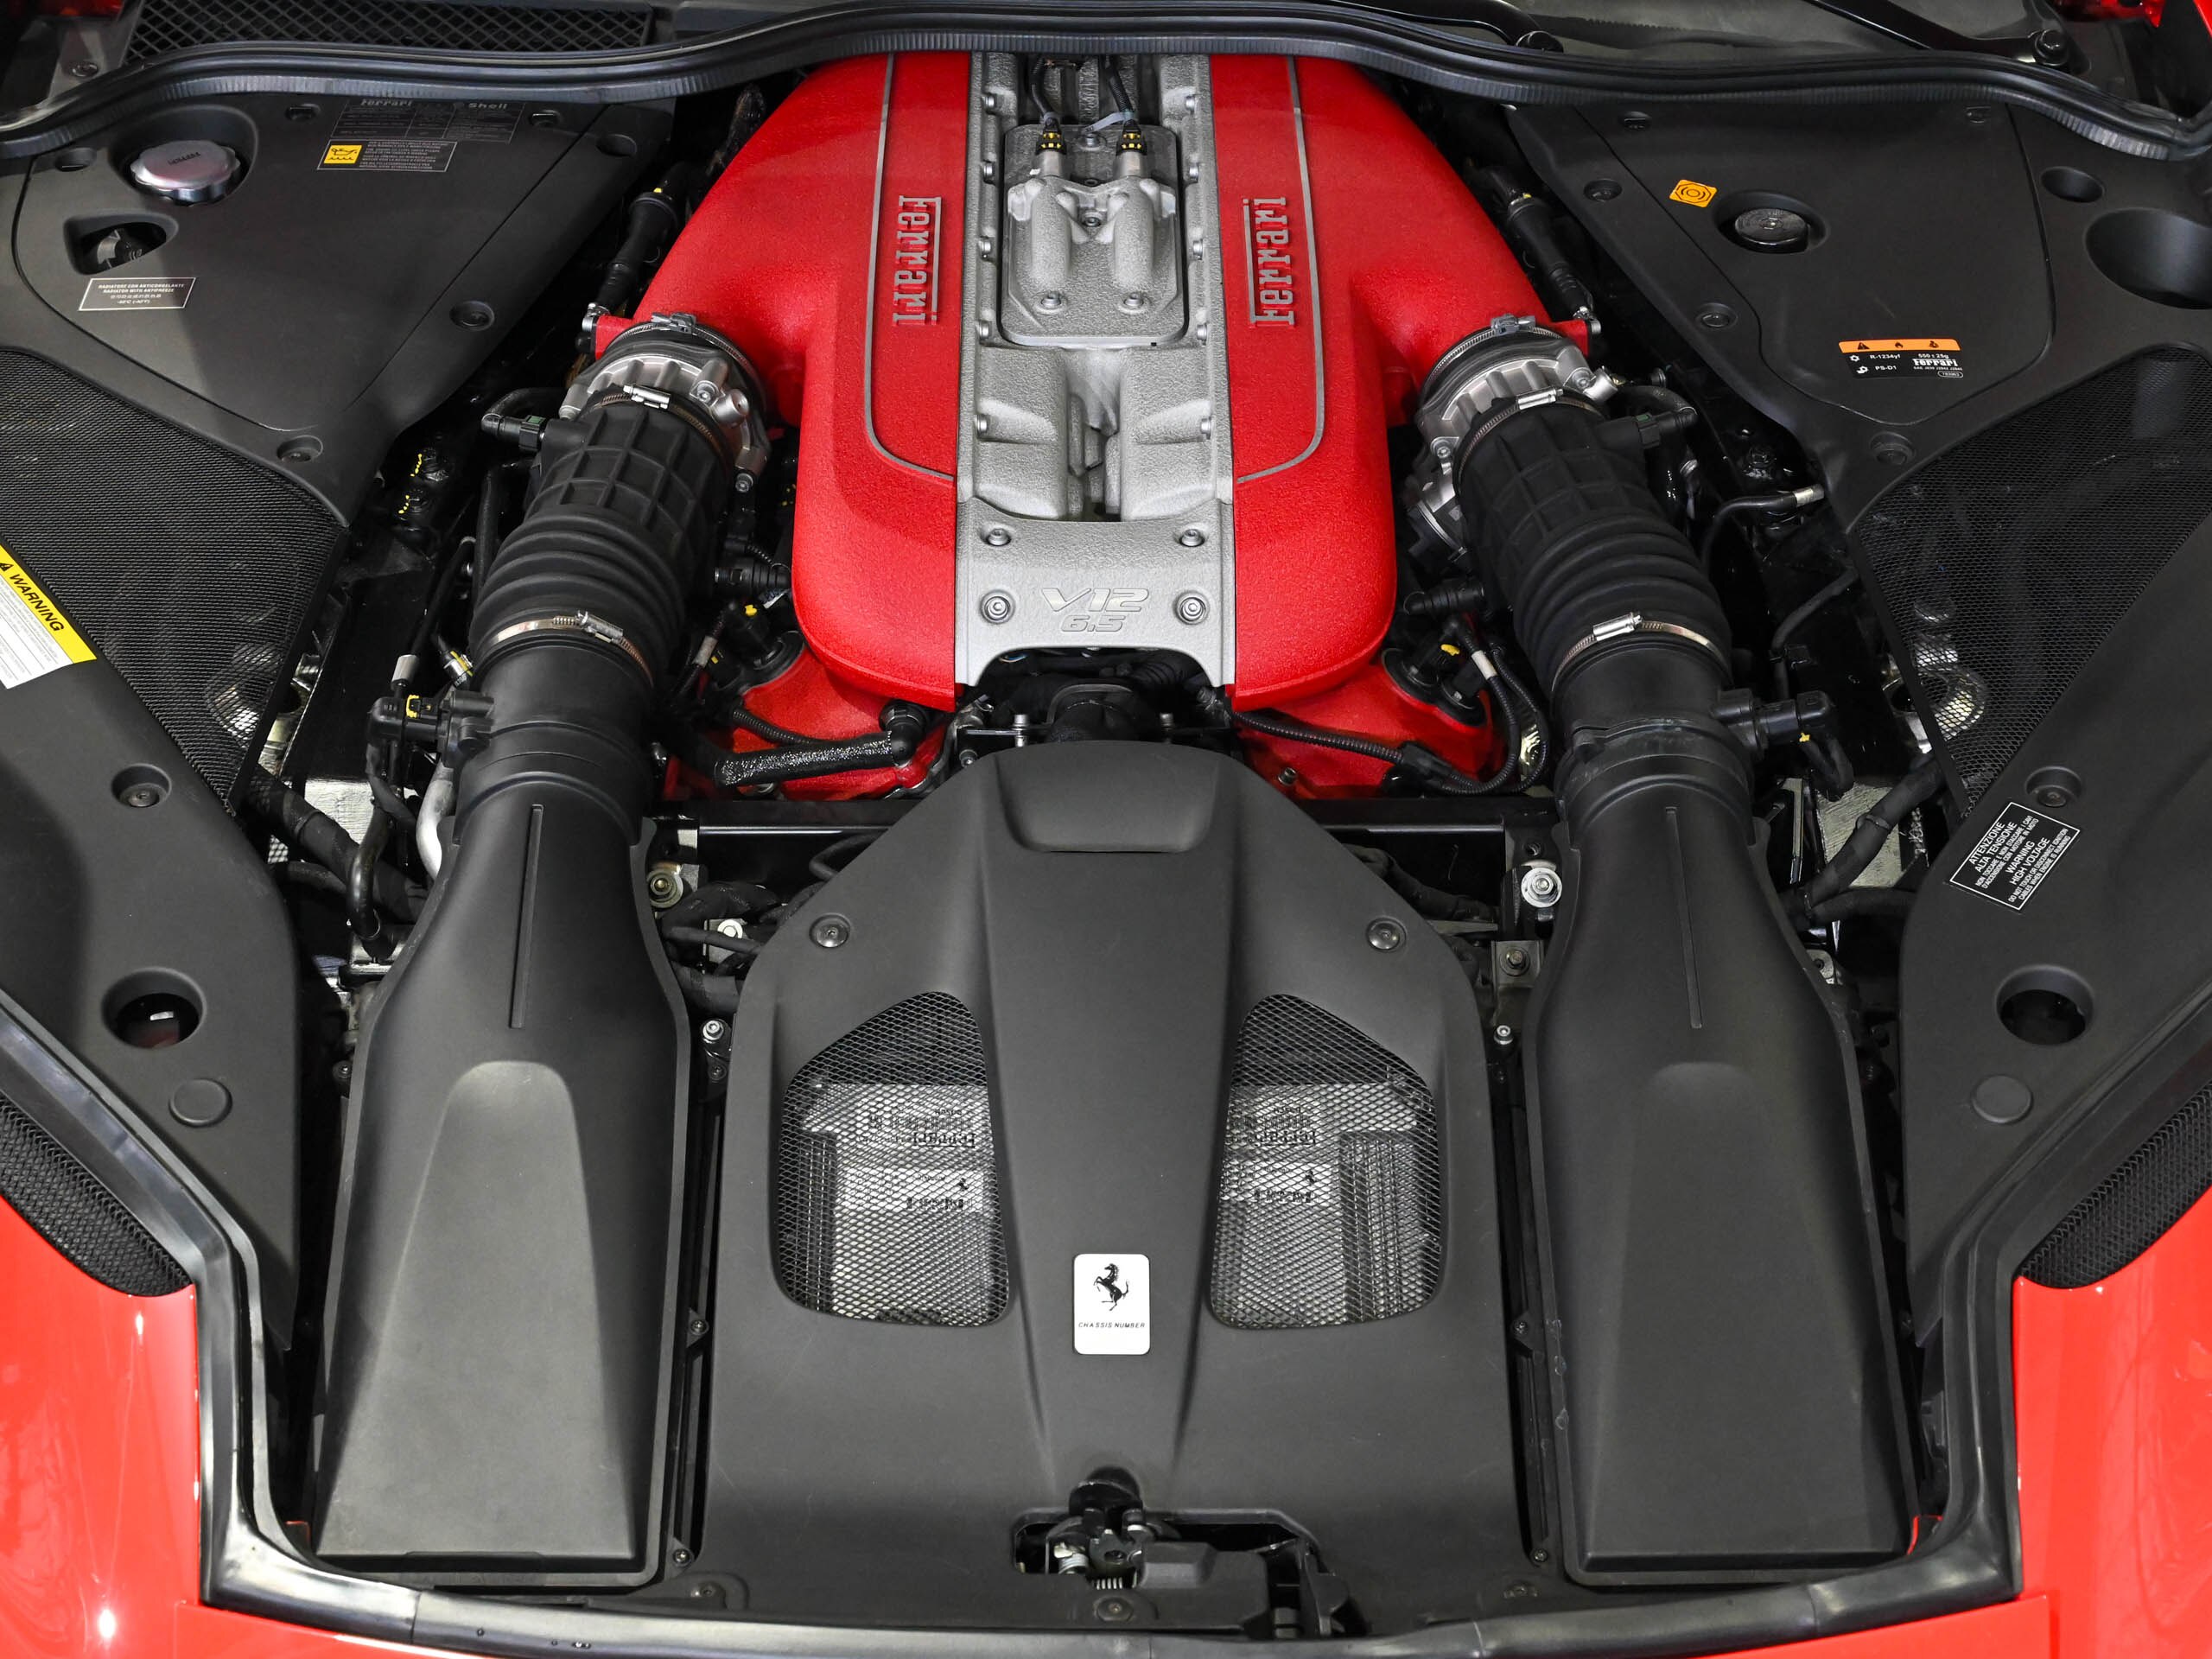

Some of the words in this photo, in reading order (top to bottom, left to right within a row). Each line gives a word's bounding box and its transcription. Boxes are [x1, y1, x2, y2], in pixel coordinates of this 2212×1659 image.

[892, 195, 942, 324] Ferrari
[1243, 197, 1295, 326] Ferrari
[10, 574, 65, 632] WARNING
[1041, 588, 1149, 612] V12
[1060, 614, 1126, 632] 6.5
[1968, 823, 2005, 864] ATTENZIONE
[1974, 856, 1991, 873] ALTA
[1987, 822, 2017, 855] TENSIONE
[1975, 877, 1986, 887] NON
[1983, 859, 1999, 877] TOCCARE
[1999, 847, 2009, 856] NON
[2006, 827, 2024, 846] STACCARE
[2023, 816, 2033, 824] CAVI
[1982, 861, 2006, 889] D'ACCENSIONE
[2003, 852, 2012, 861] CON
[2010, 836, 2026, 853] MOTORE
[2028, 818, 2039, 830] MOTO
[2005, 841, 2035, 874] WARNING
[2010, 867, 2026, 885] HIGH
[2023, 837, 2050, 867] VOLTAGE
[2013, 884, 2023, 896] NOT
[2019, 871, 2033, 888] TOUCH
[2030, 867, 2037, 875] OR
[2034, 844, 2056, 869] DISCONNECT
[2052, 828, 2069, 845] IGNITION
[2018, 885, 2033, 899] CABLES
[2031, 873, 2043, 885] WHEN
[2039, 859, 2053, 873] ENGINE
[2055, 836, 2070, 854] RUNNING
